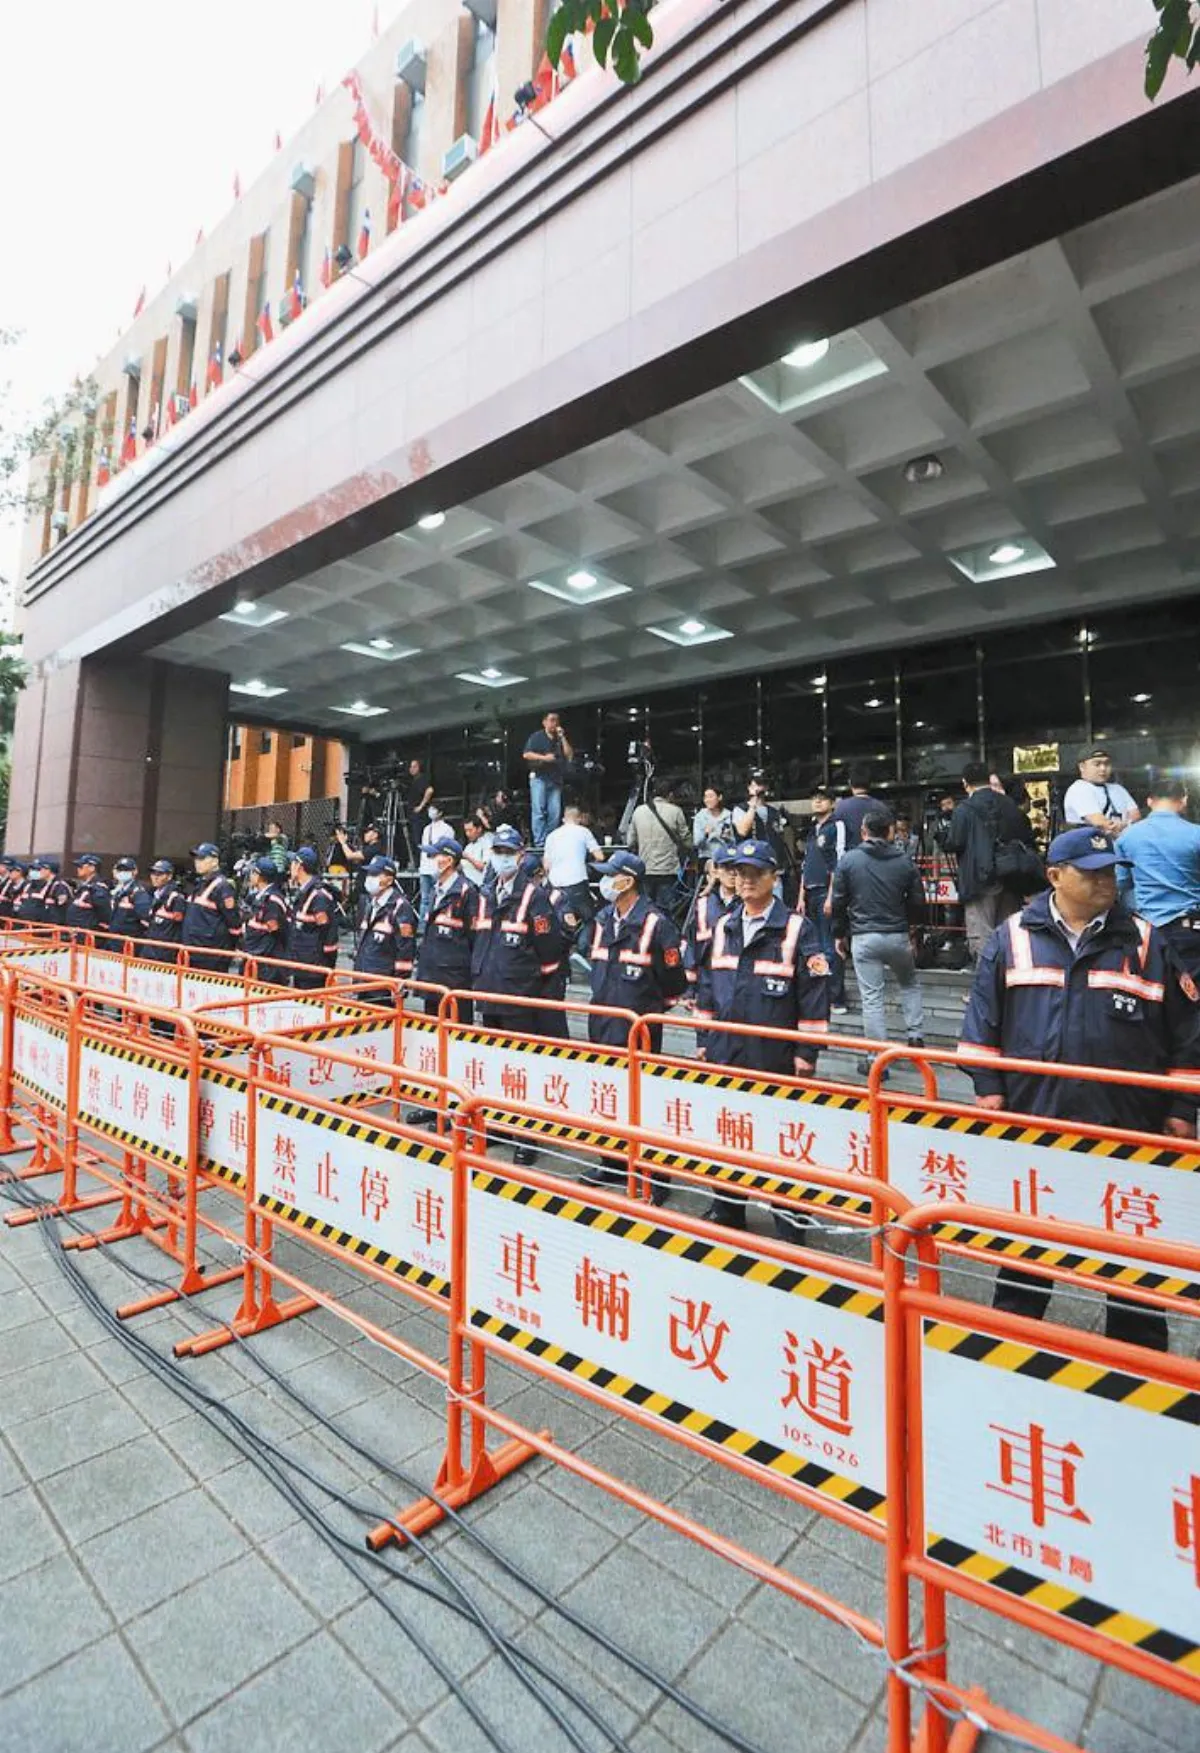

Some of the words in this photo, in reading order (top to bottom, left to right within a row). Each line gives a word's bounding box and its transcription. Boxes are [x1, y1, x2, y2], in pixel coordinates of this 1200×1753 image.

[464, 1057, 618, 1120] 車輛改道
[272, 1133, 446, 1245] 禁止停車
[496, 1231, 854, 1437] 車輛改道
[782, 1424, 860, 1468] 105-026
[985, 1423, 1200, 1592] 車
[983, 1523, 1093, 1583] 北市警局
